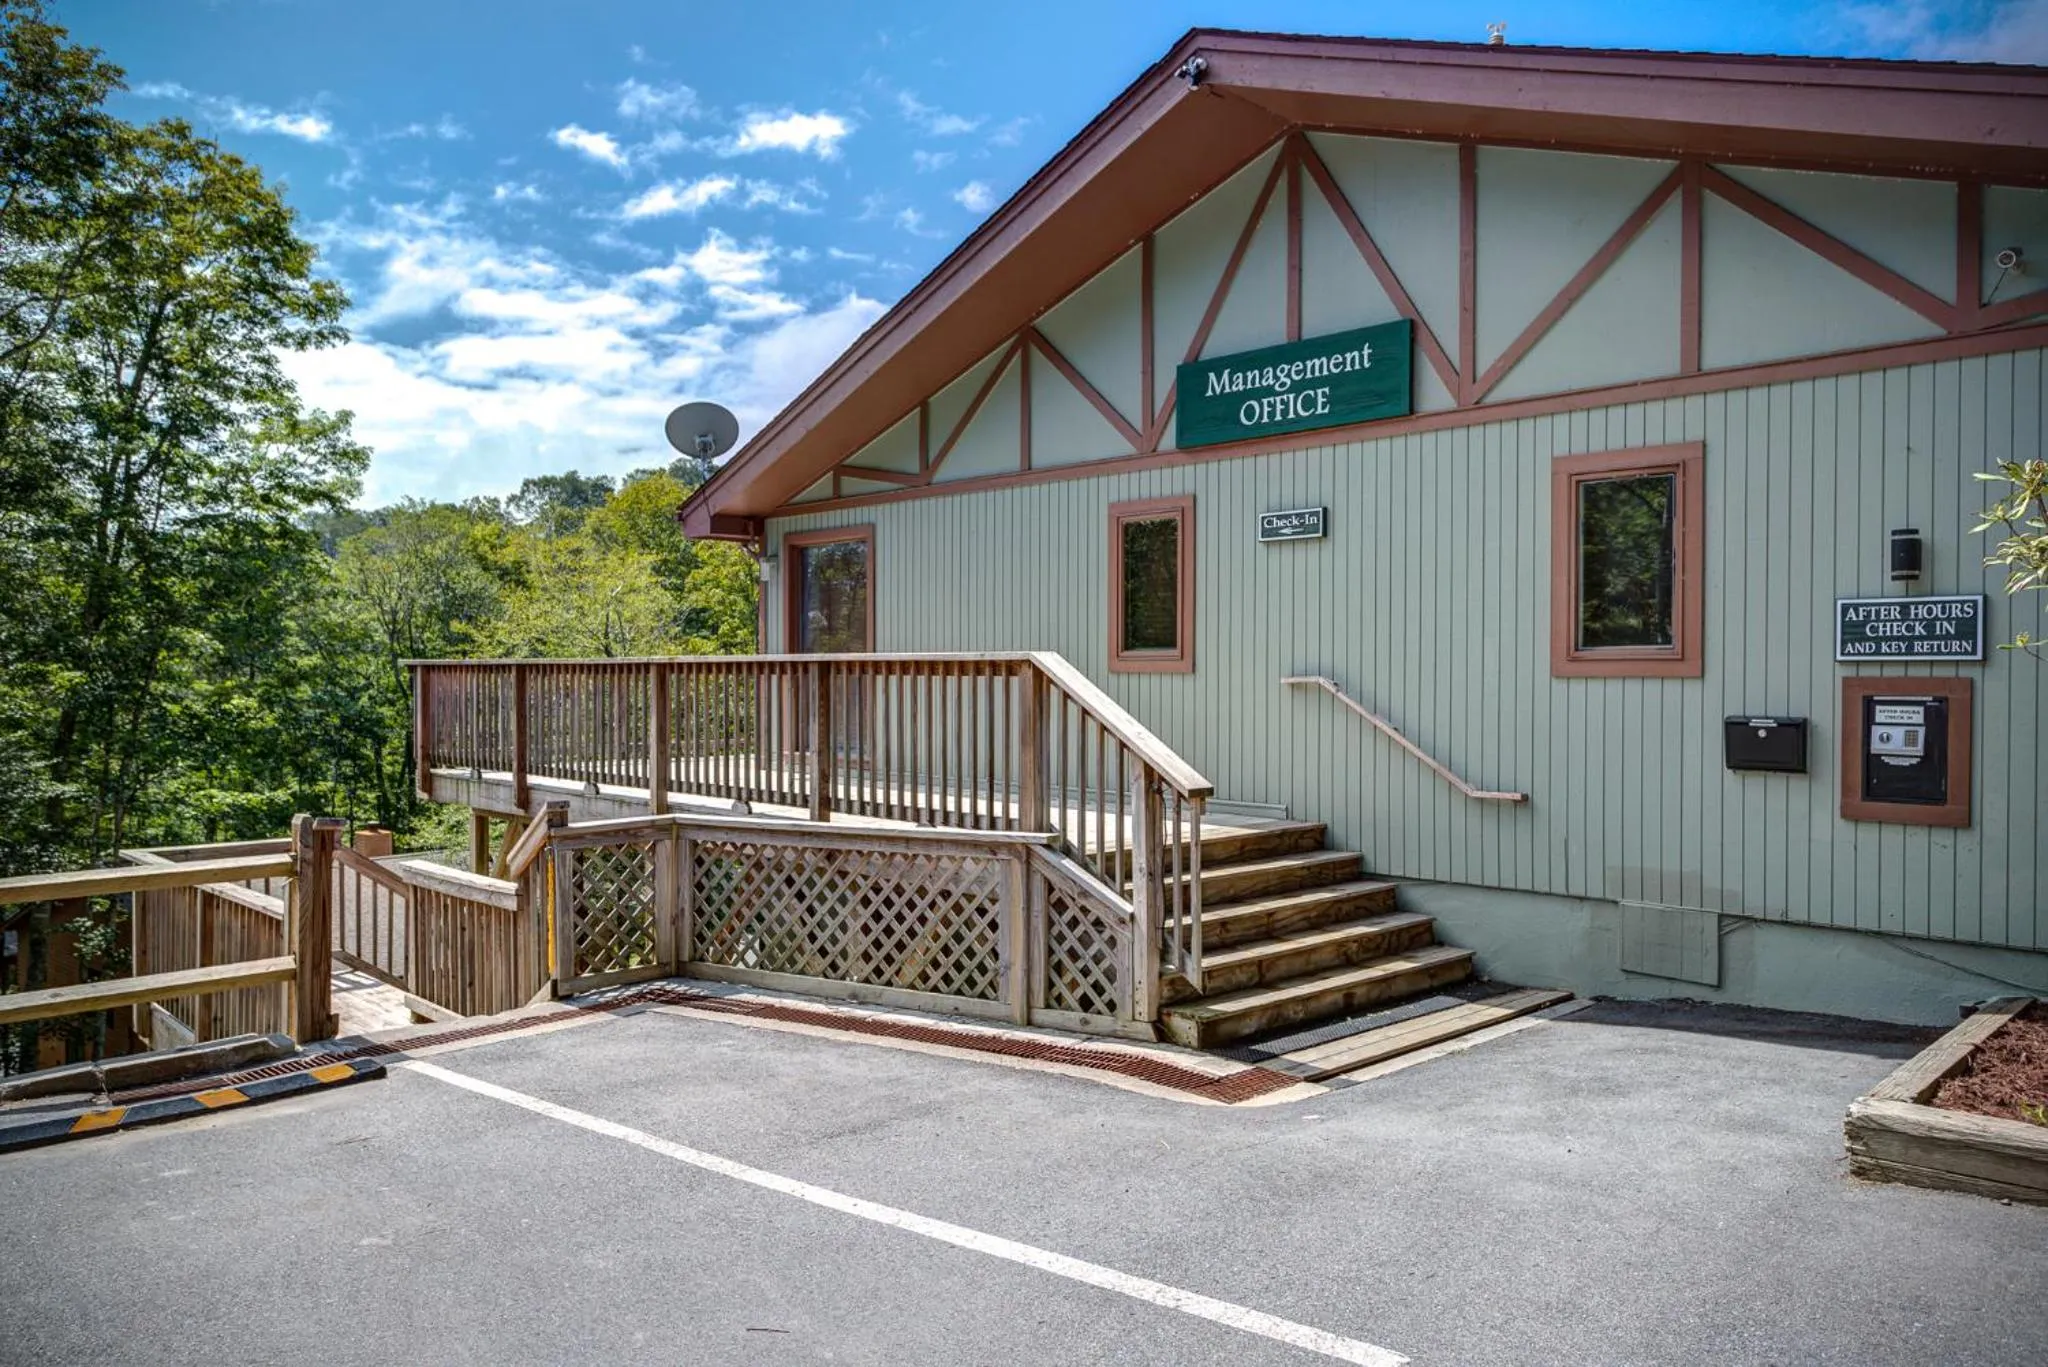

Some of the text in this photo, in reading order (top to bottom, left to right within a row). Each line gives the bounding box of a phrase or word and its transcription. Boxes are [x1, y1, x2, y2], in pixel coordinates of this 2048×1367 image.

[1205, 342, 1373, 397] Management
[1239, 387, 1331, 426] OFFICE
[1263, 514, 1318, 528] Check-In
[1845, 602, 1974, 621] AFTER HOURS
[1865, 620, 1956, 637] CHECK IN
[1843, 640, 1973, 654] AND KEY RETURN
